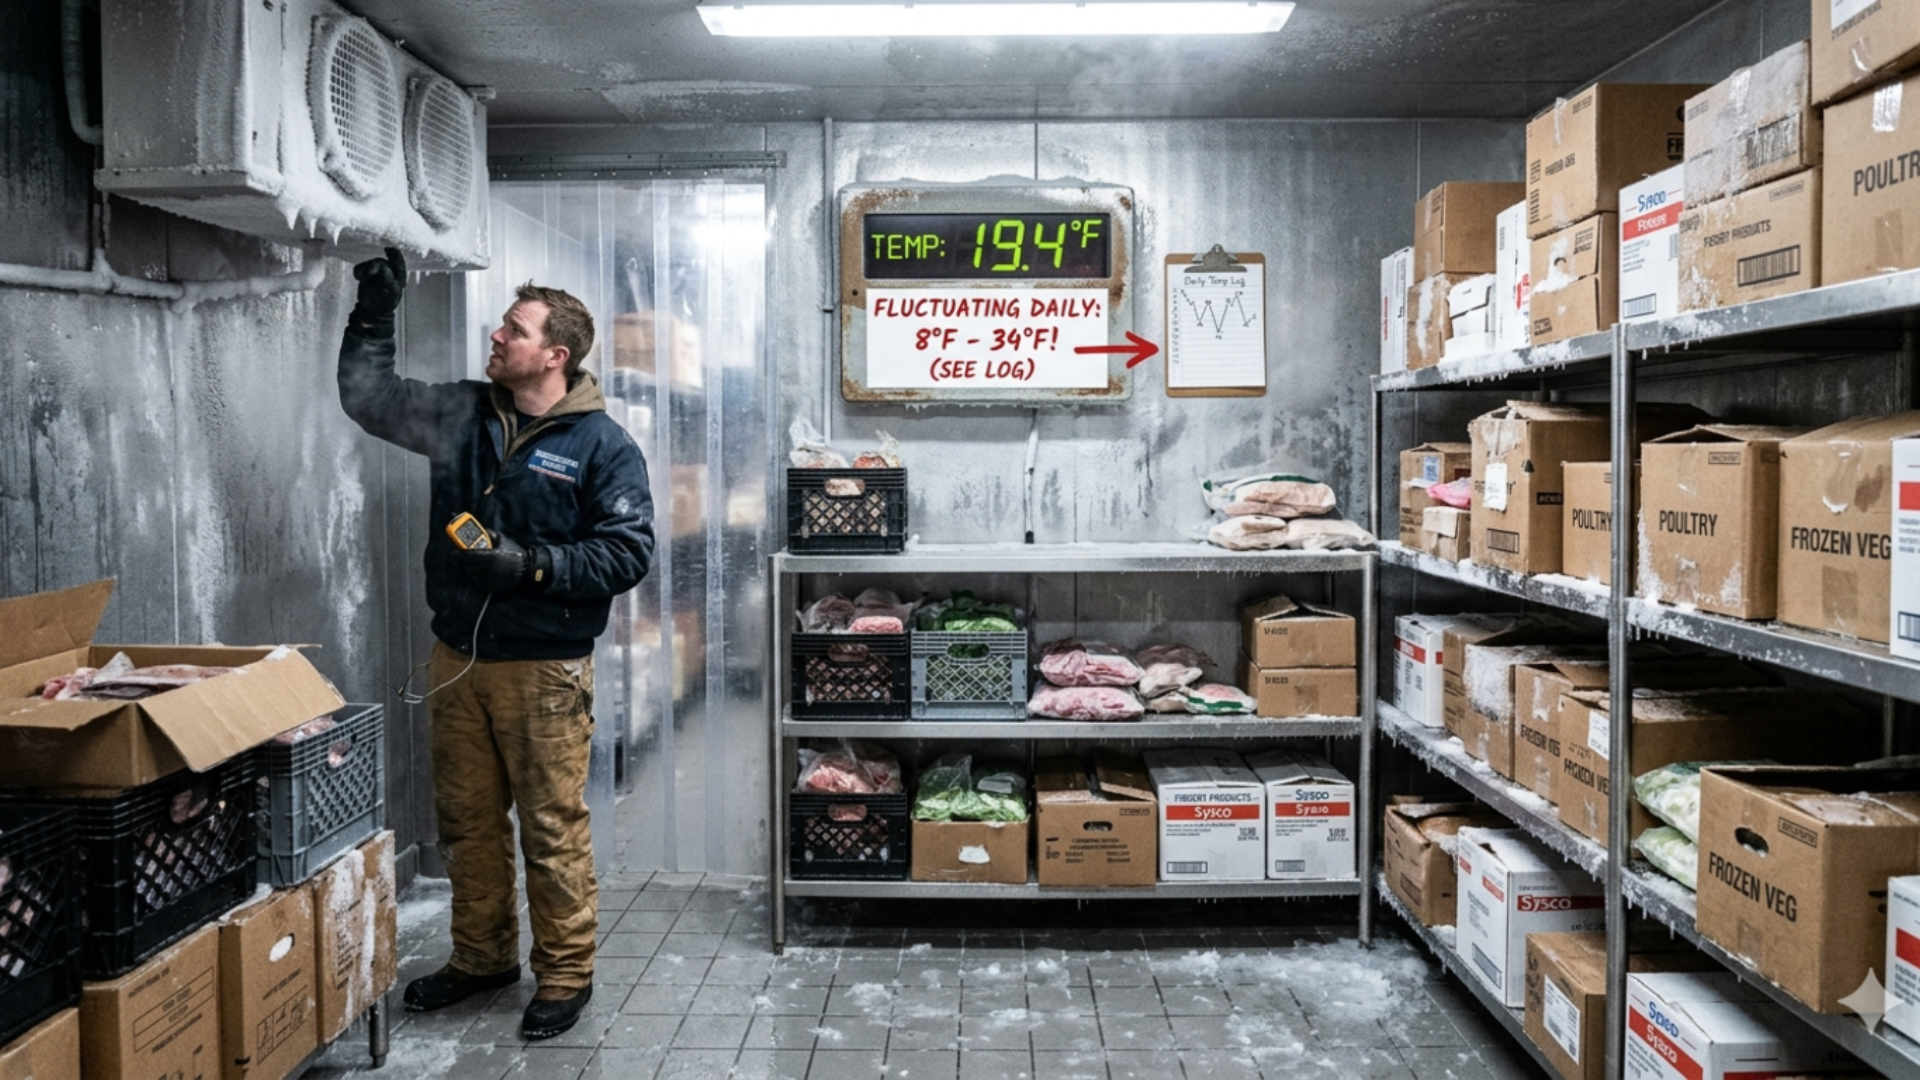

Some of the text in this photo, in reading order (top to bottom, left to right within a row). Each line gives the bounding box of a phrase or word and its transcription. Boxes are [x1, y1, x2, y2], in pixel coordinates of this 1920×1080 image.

[871, 234, 946, 259] TEMP:
[874, 298, 1101, 318] FLUCTUATING DAILY:
[915, 327, 958, 351] 8°F
[990, 326, 1059, 351] 34°F!
[930, 357, 1035, 382] (SEE LOG)
[1659, 509, 1718, 537] POULTRY
[1791, 526, 1851, 556] FROZEN
[1857, 532, 1892, 560] VEG
[1194, 806, 1232, 821] Sysco
[1709, 851, 1798, 923] FROZEN VEG
[1521, 895, 1572, 913] Sysco
